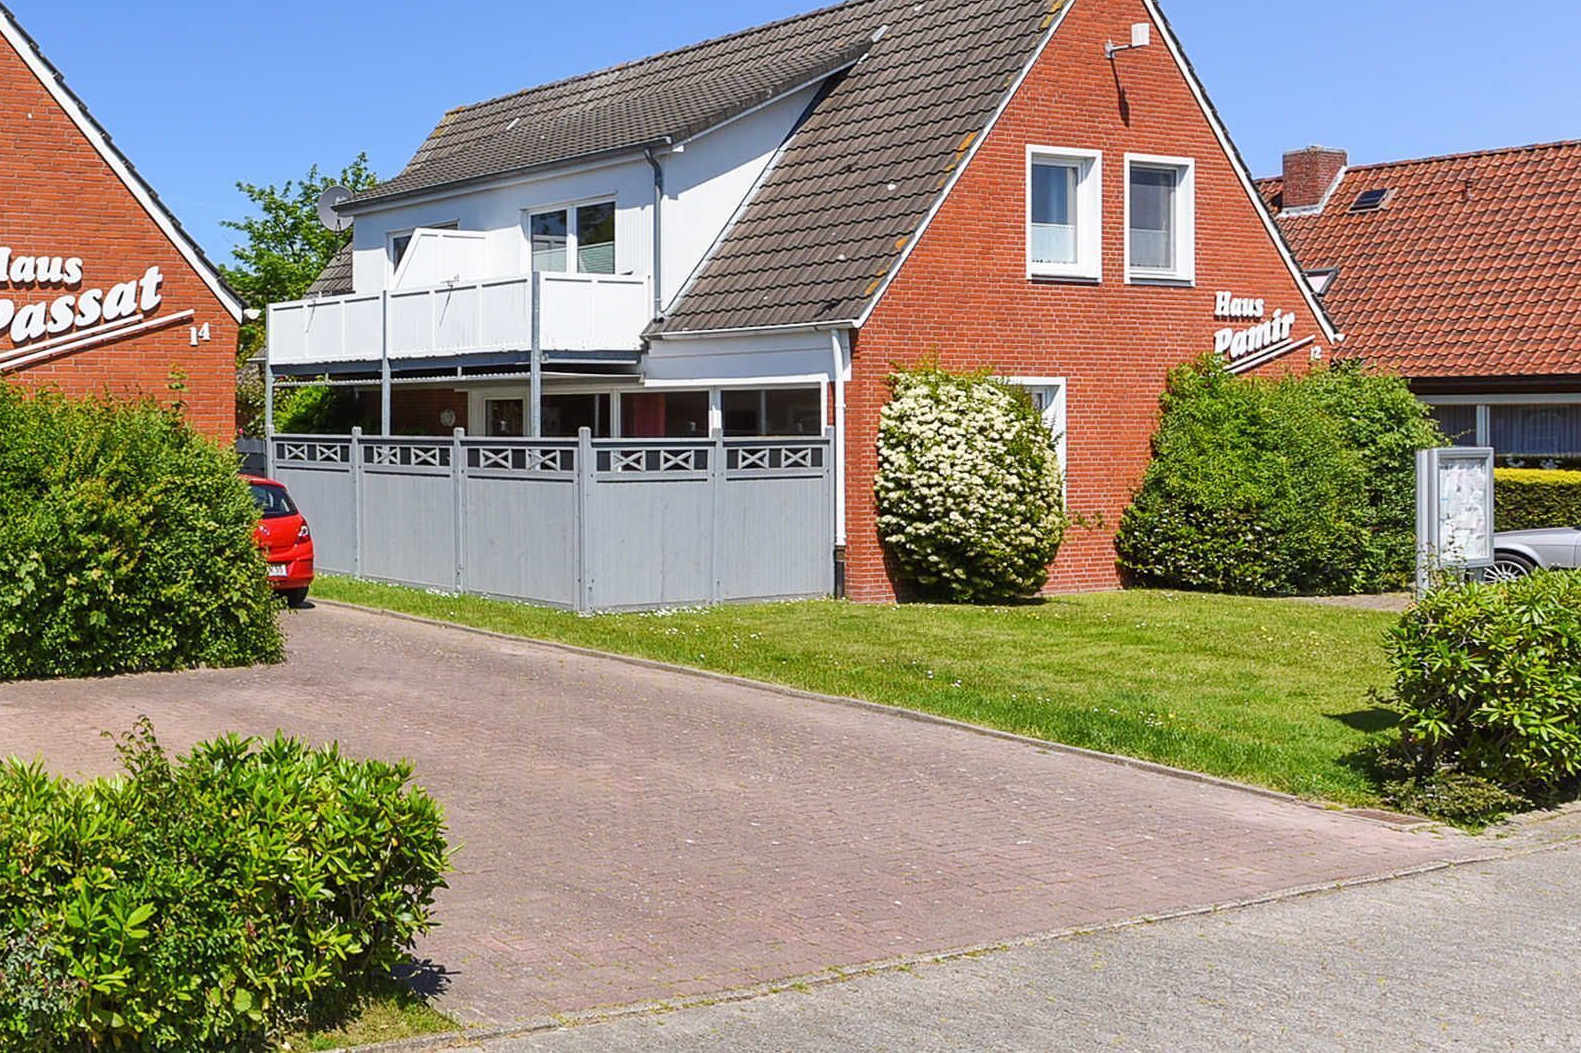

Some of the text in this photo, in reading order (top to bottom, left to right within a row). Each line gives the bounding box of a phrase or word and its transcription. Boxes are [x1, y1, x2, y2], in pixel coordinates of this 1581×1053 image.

[1214, 291, 1264, 317] Haus
[189, 322, 211, 346] 14
[1214, 308, 1295, 357] Pamir
[1310, 346, 1322, 360] 12
